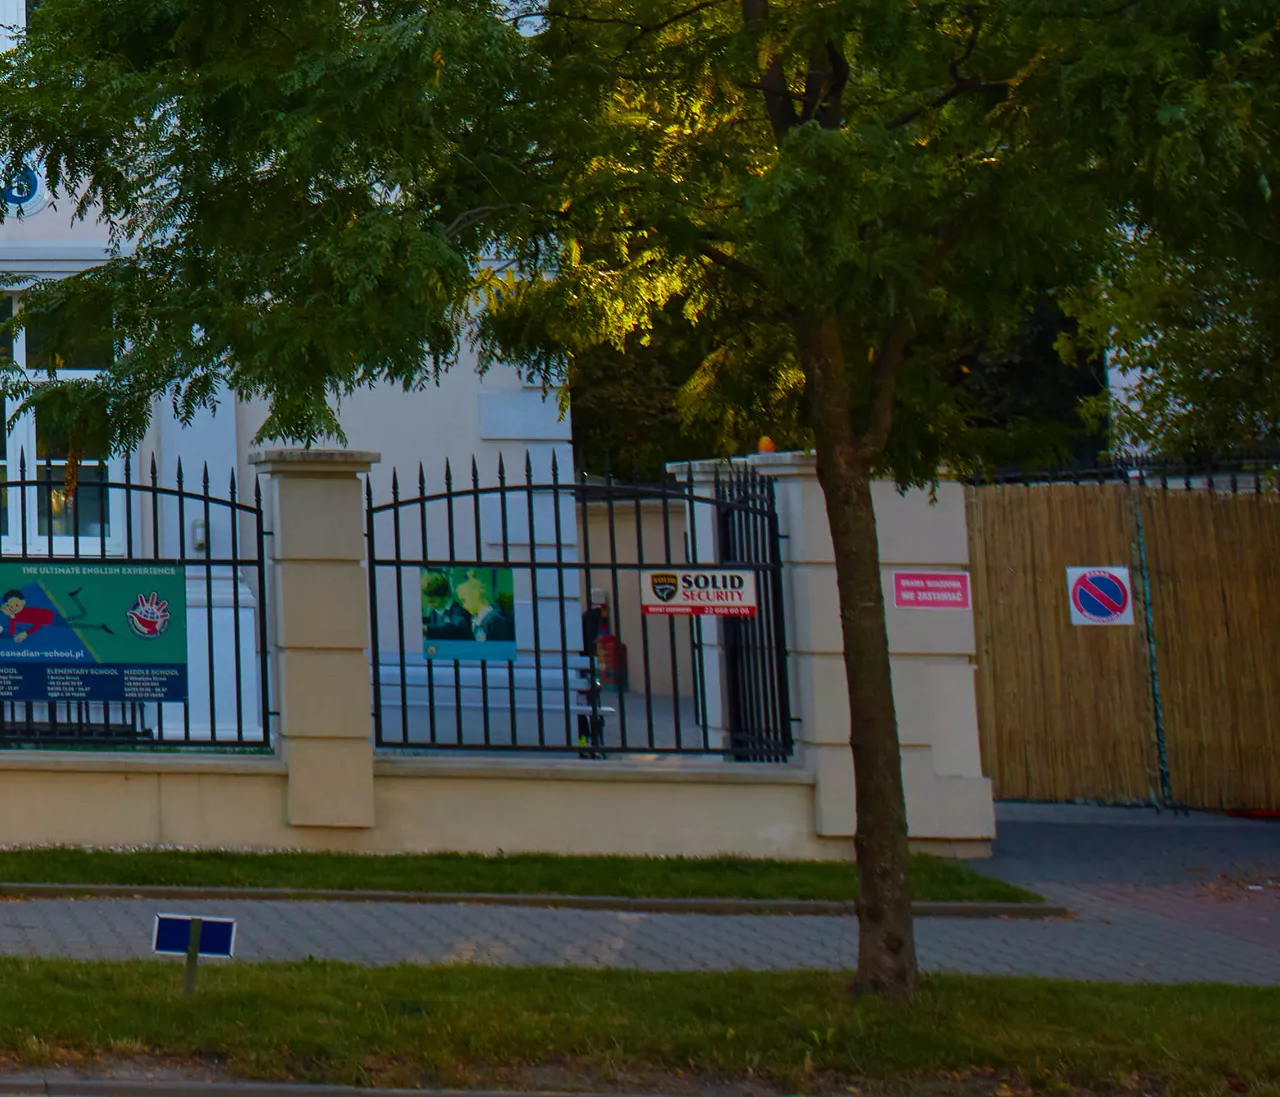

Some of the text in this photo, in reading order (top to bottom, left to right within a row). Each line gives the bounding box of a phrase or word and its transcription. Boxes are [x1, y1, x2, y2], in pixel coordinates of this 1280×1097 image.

[22, 566, 176, 576] THE ULTIMATE ENGLISH EXPERIENCE
[681, 573, 745, 590] SOLID
[682, 589, 745, 602] SECURITY
[901, 591, 915, 601] NIE
[150, 669, 180, 677] SCHOOL
